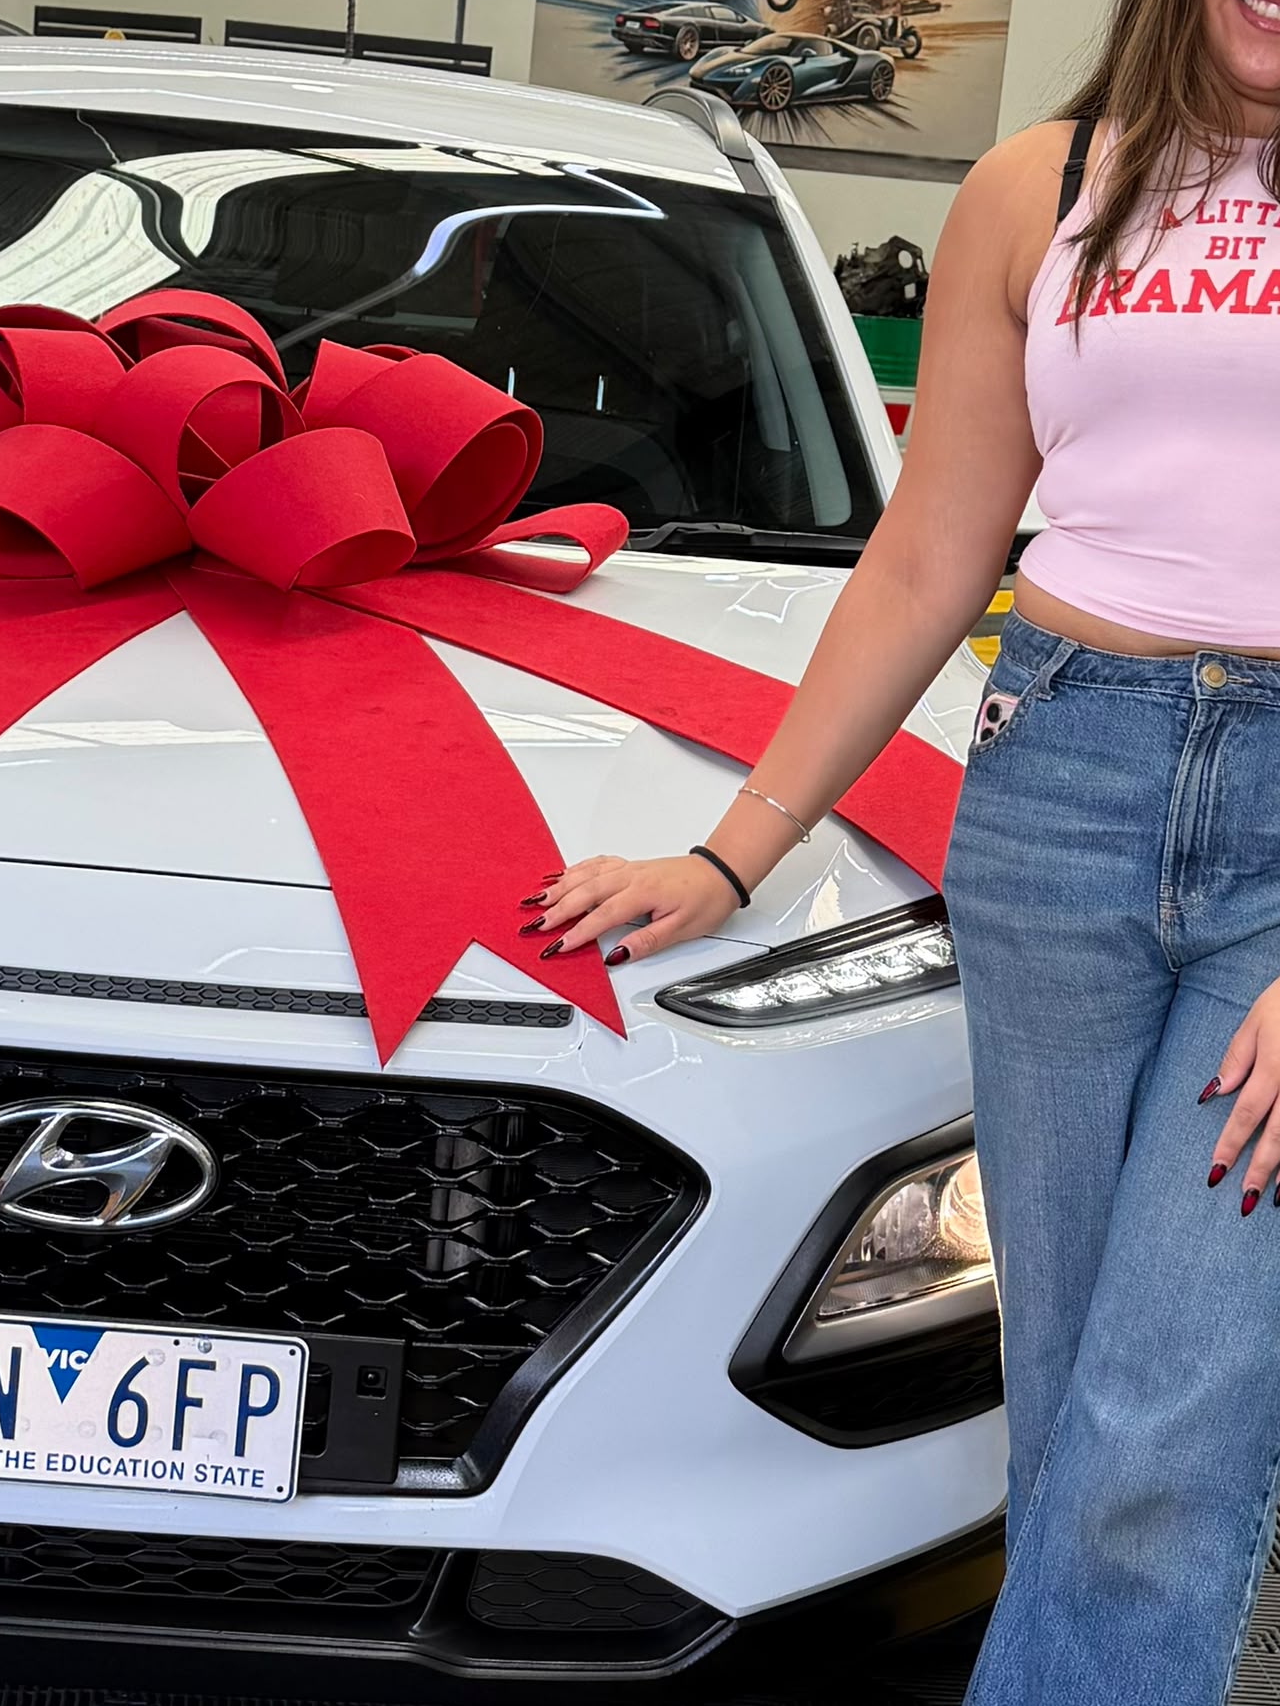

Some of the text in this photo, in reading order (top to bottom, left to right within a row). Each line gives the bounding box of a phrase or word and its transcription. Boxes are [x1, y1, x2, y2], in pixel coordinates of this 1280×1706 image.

[1160, 207, 1183, 231] A
[1205, 236, 1266, 260] BIT
[39, 1346, 93, 1372] VIC
[106, 1355, 281, 1458] 6FP
[46, 1454, 185, 1481] EDUCATION
[194, 1464, 266, 1489] STATE
